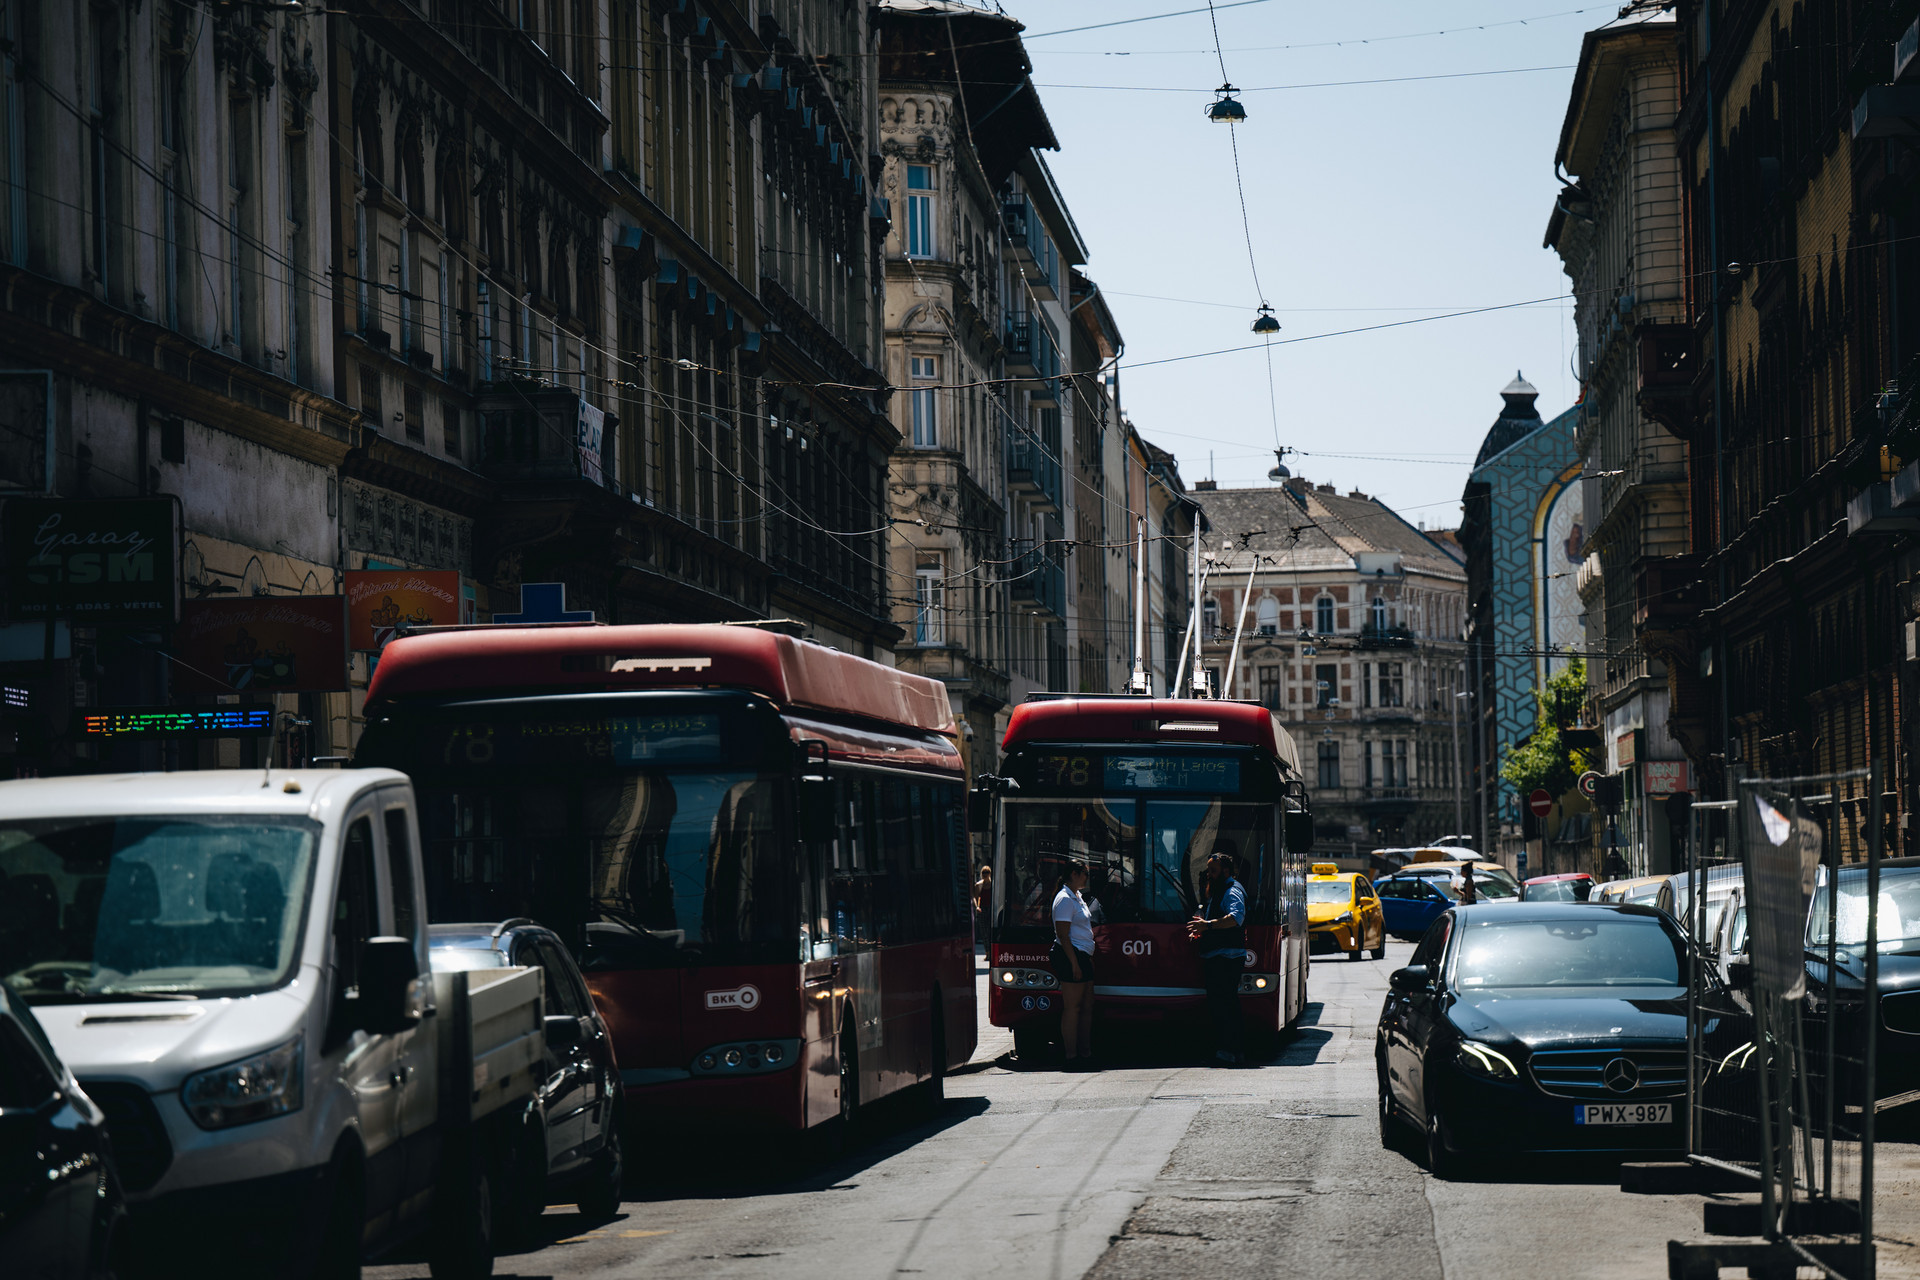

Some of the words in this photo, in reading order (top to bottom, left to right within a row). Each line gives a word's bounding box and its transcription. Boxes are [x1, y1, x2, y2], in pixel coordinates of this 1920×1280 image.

[33, 512, 155, 562] Garay
[26, 552, 154, 584] GSM
[1049, 756, 1090, 786] 78
[1181, 758, 1227, 774] Lajos
[1649, 778, 1677, 793] ABC
[1122, 940, 1152, 956] 601
[712, 995, 736, 1004] BKK
[1587, 1105, 1668, 1123] PWX-987
